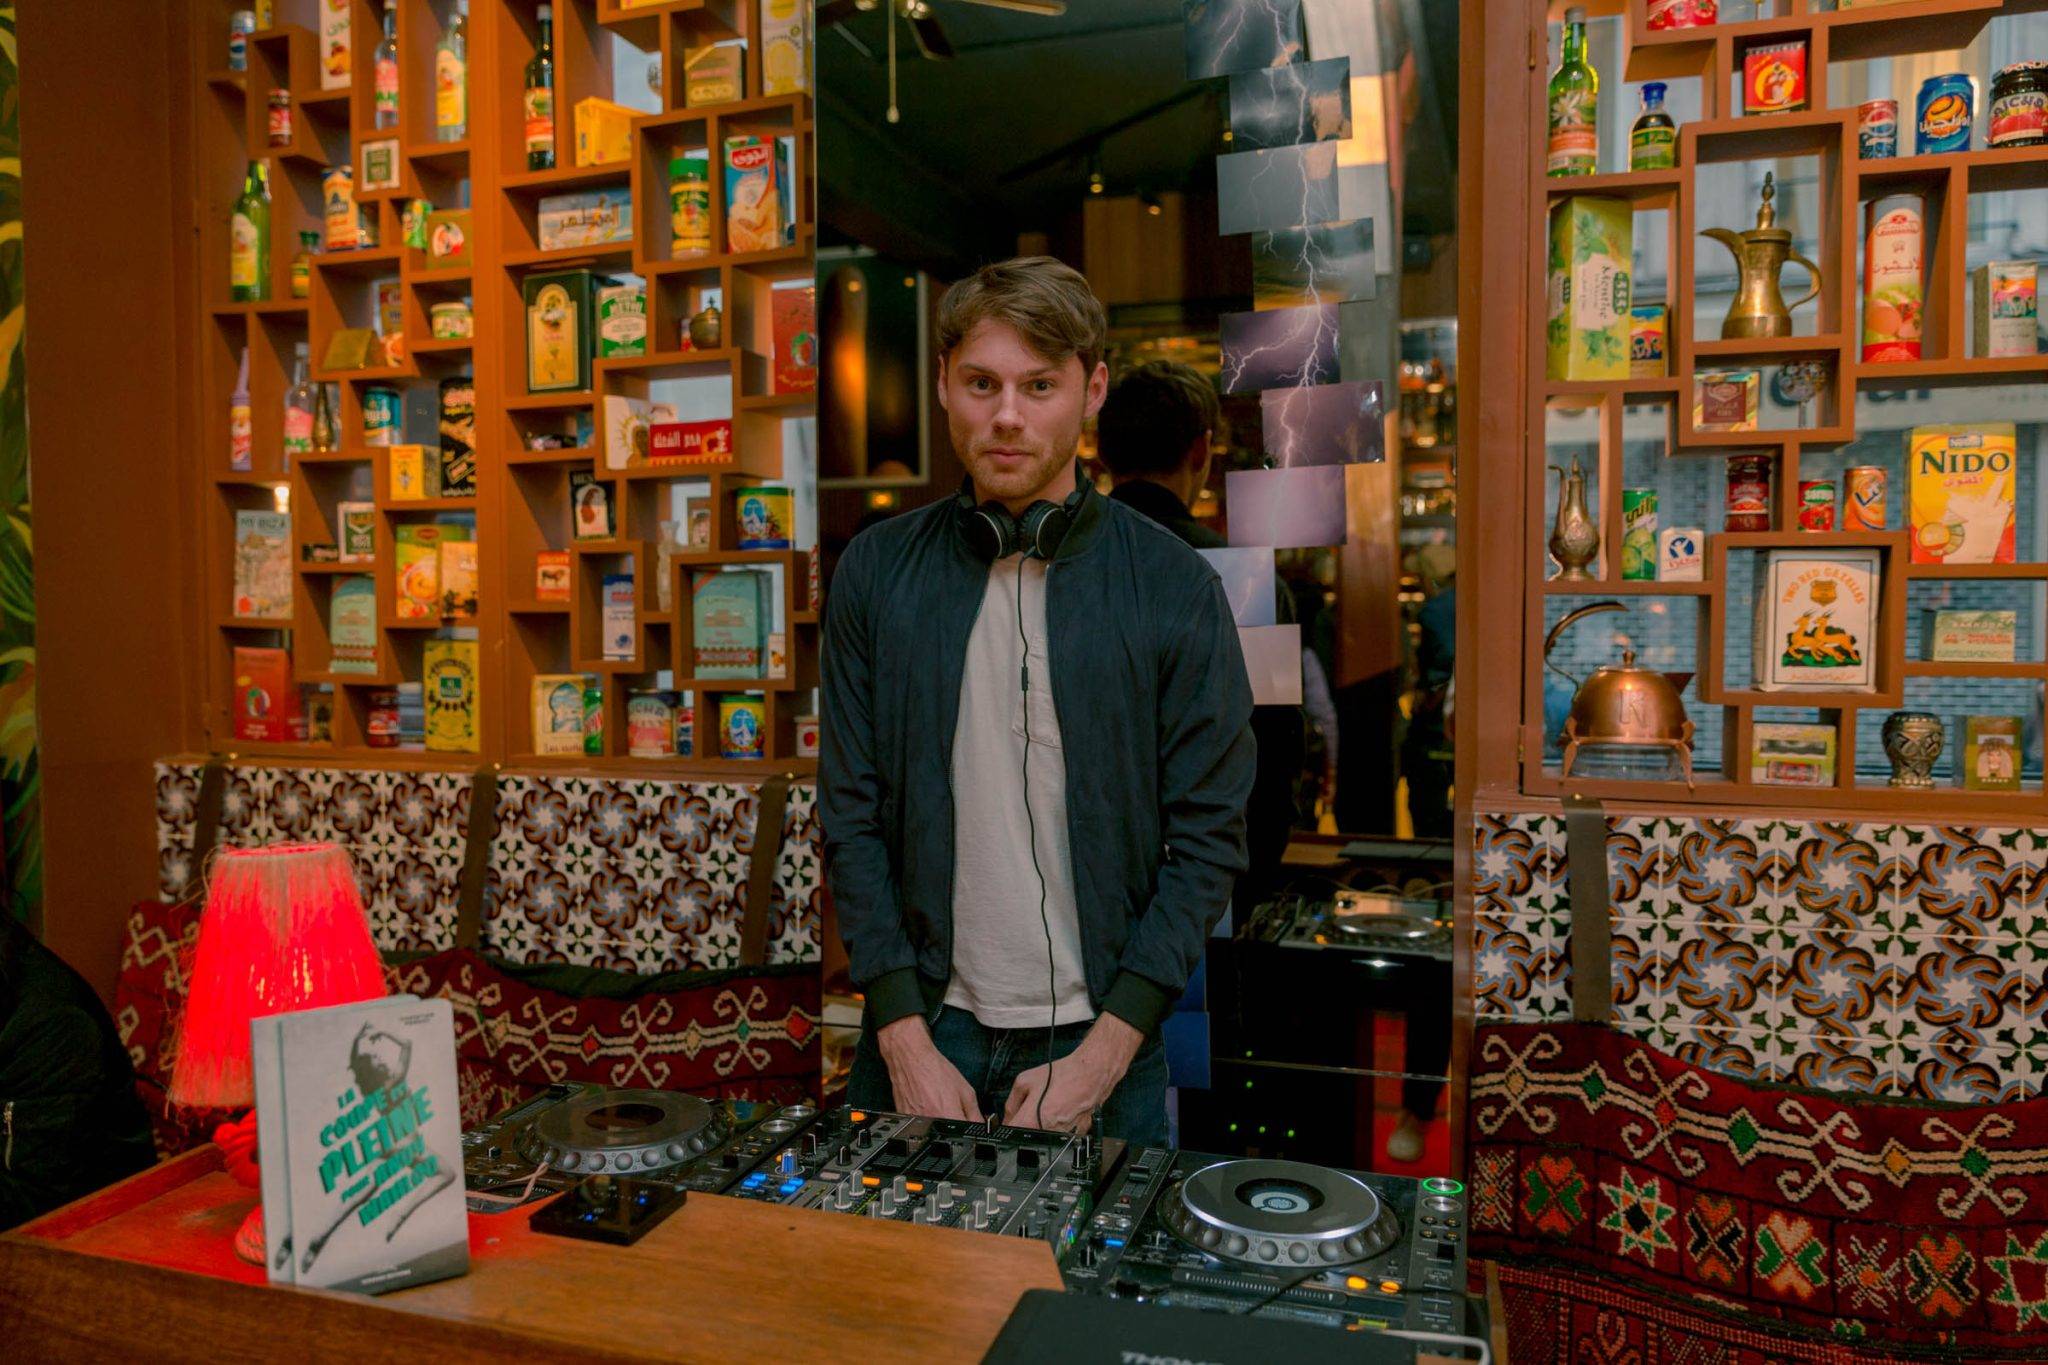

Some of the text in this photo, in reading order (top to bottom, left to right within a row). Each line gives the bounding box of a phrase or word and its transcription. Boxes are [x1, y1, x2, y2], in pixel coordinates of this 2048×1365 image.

[1920, 450, 2011, 474] NIDO
[318, 1085, 434, 1194] PLEINE
[320, 1087, 388, 1147] COUPE
